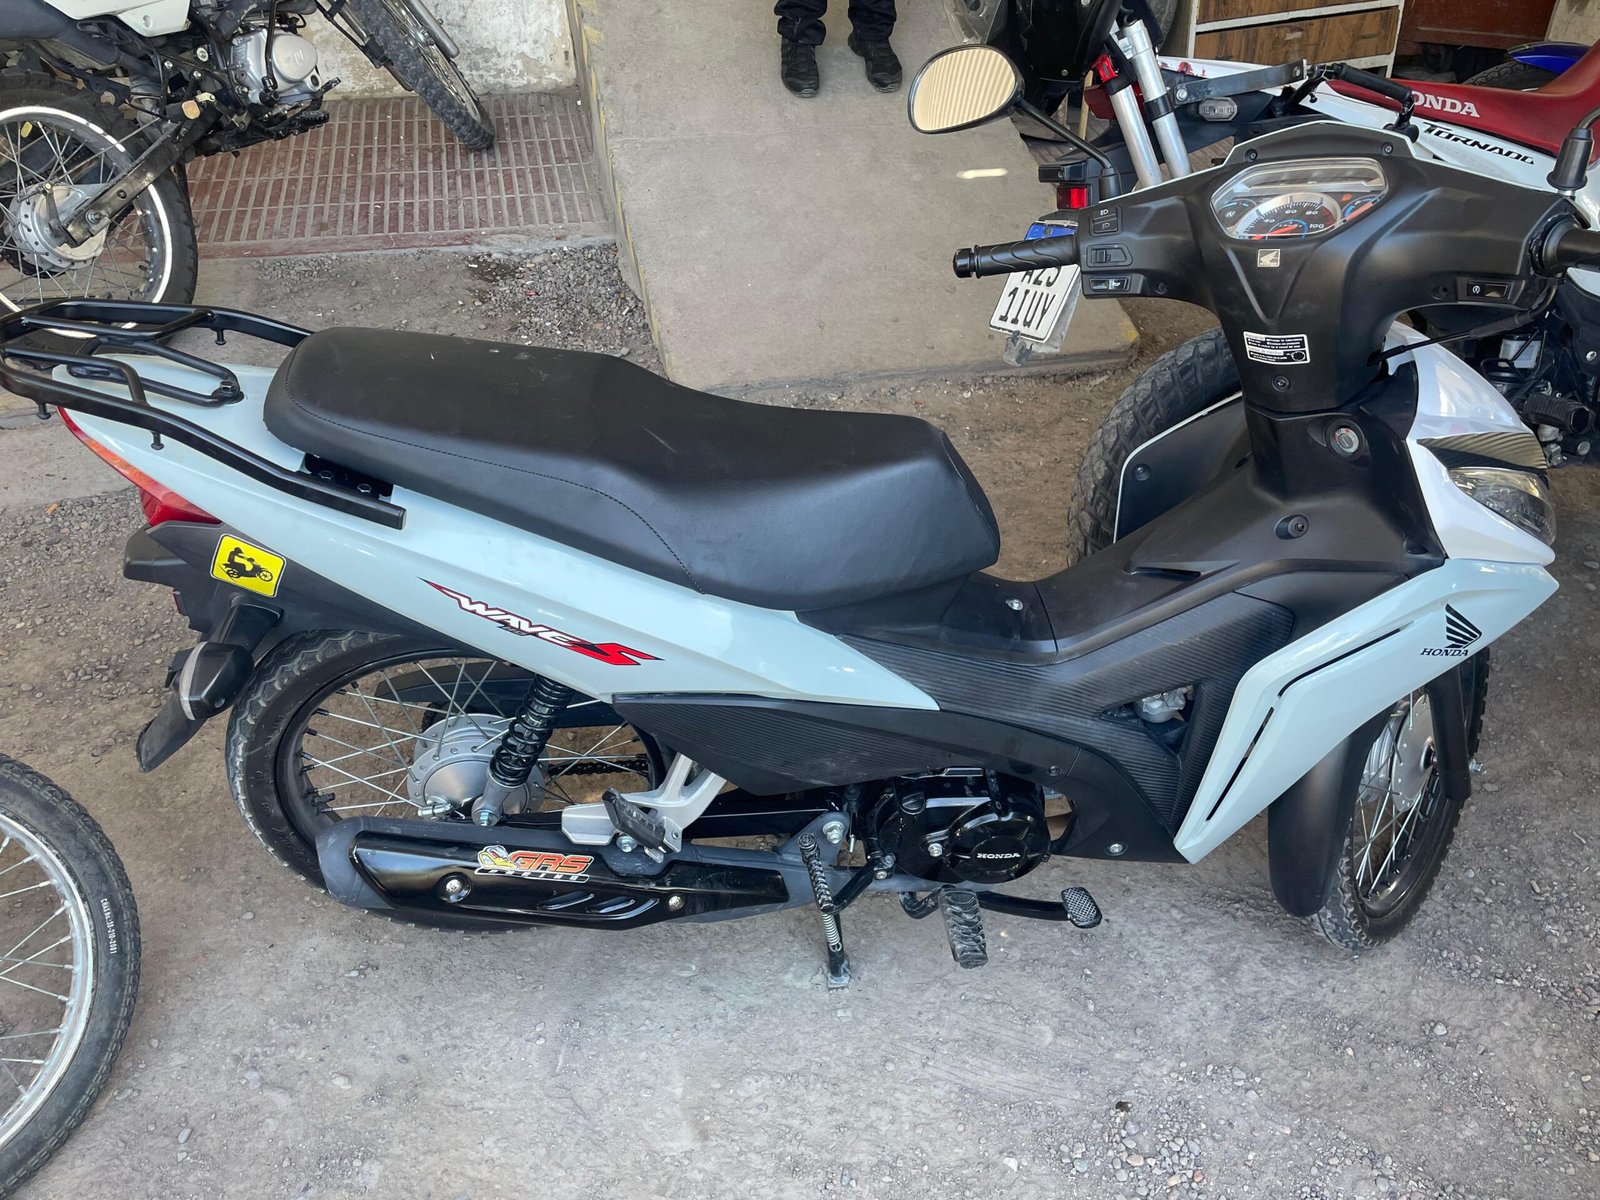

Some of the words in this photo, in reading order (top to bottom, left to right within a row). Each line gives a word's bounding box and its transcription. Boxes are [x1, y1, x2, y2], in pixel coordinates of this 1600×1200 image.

[1411, 90, 1481, 118] ONDA
[1420, 647, 1469, 657] HONDA
[508, 850, 595, 875] GRS
